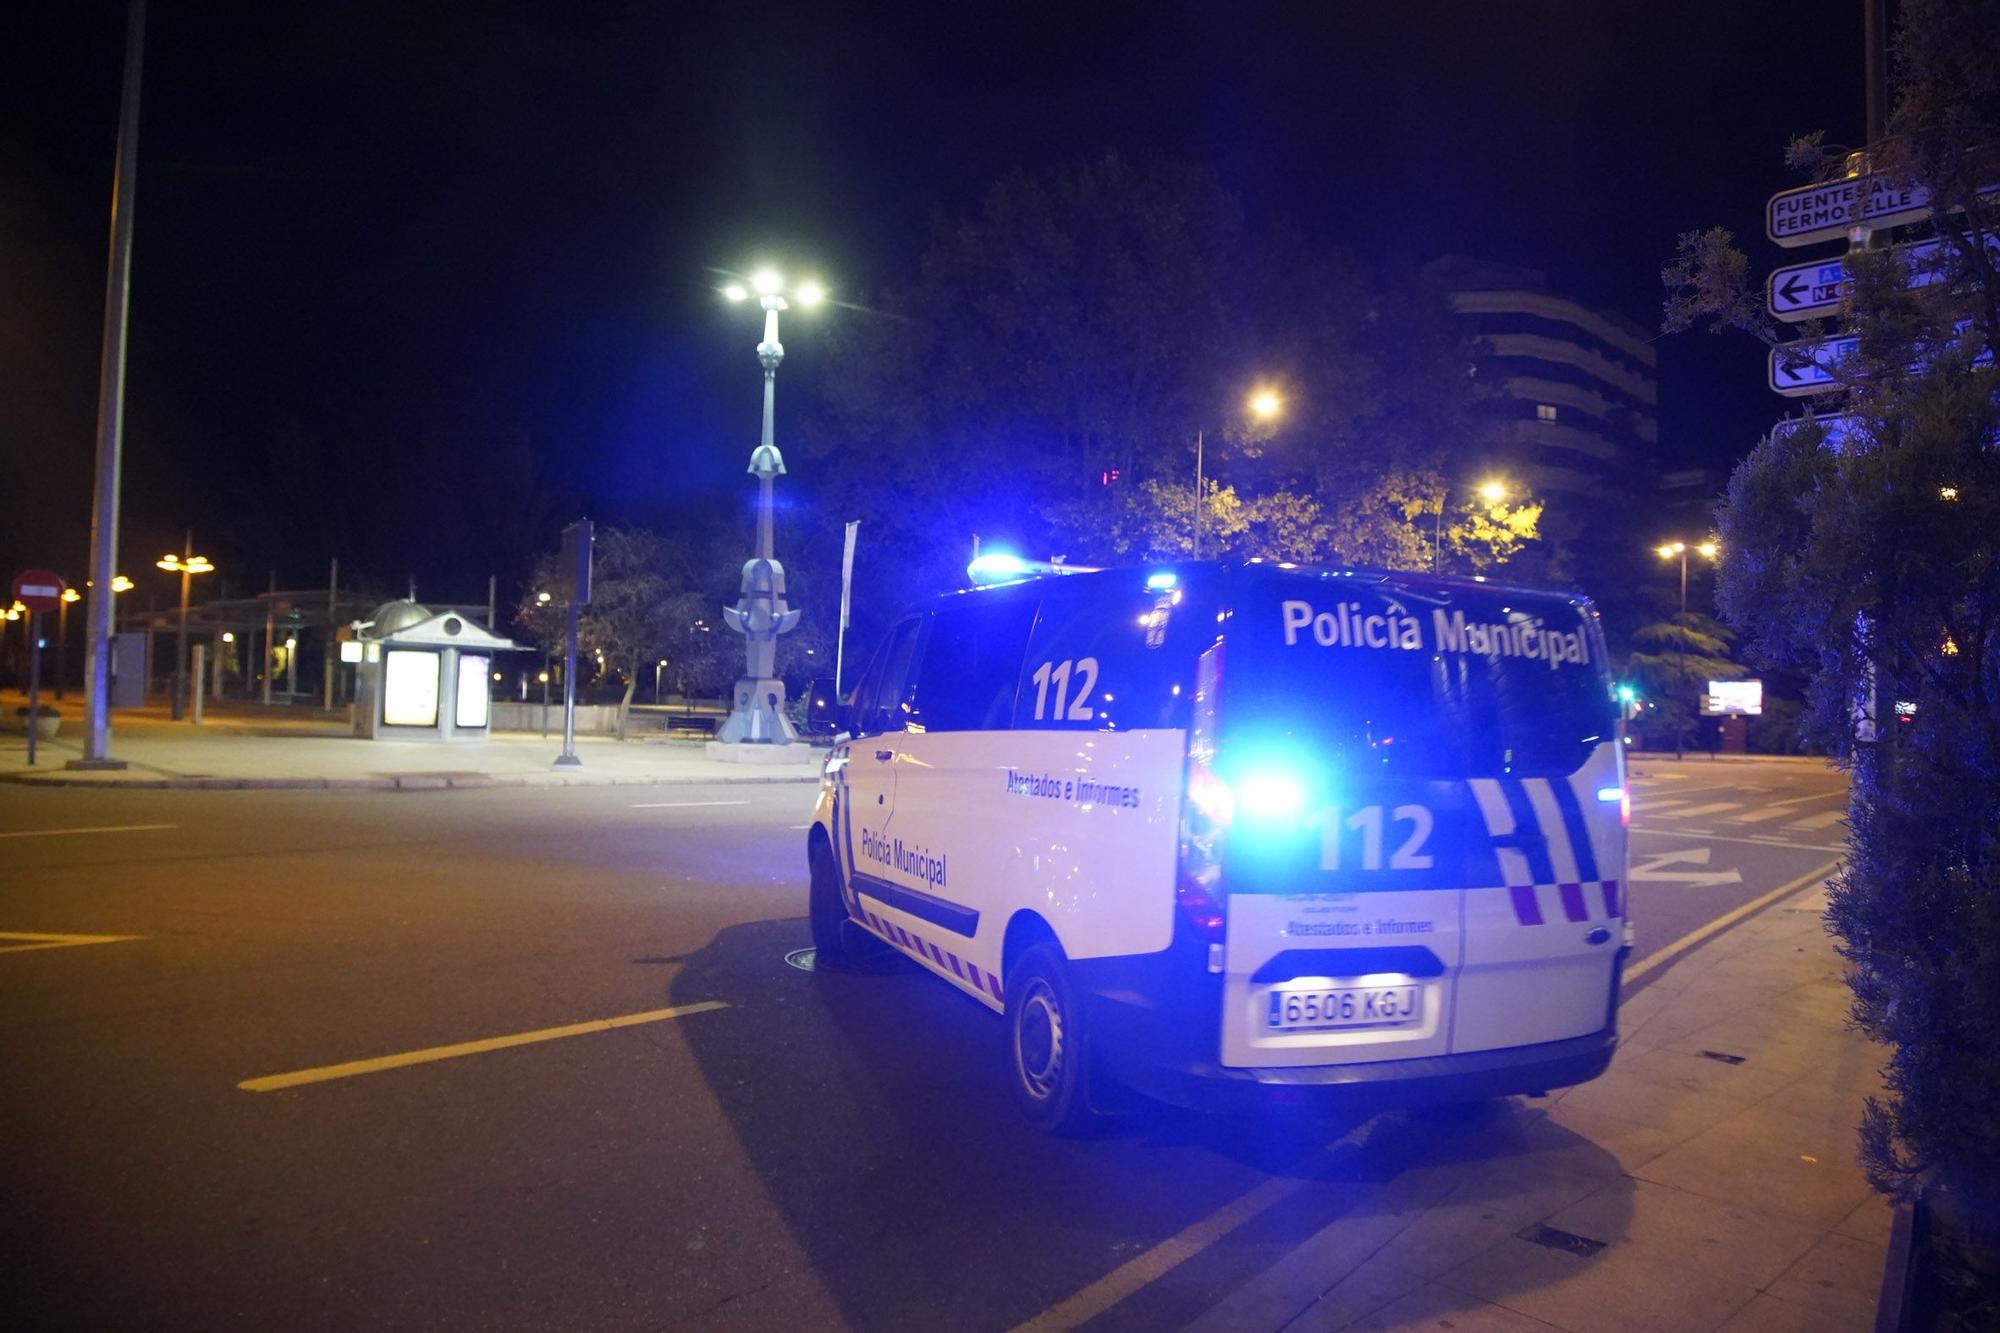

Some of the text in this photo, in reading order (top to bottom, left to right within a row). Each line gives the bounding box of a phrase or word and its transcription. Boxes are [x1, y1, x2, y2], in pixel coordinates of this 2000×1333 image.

[1282, 600, 1589, 670] Policía Municipal
[1032, 657, 1099, 721] 112
[1006, 770, 1062, 799] Atestados
[1065, 781, 1073, 800] e
[862, 828, 947, 888] Policía Municipal
[1308, 804, 1434, 871] 112
[1286, 990, 1417, 1022] 6506 KGJ
